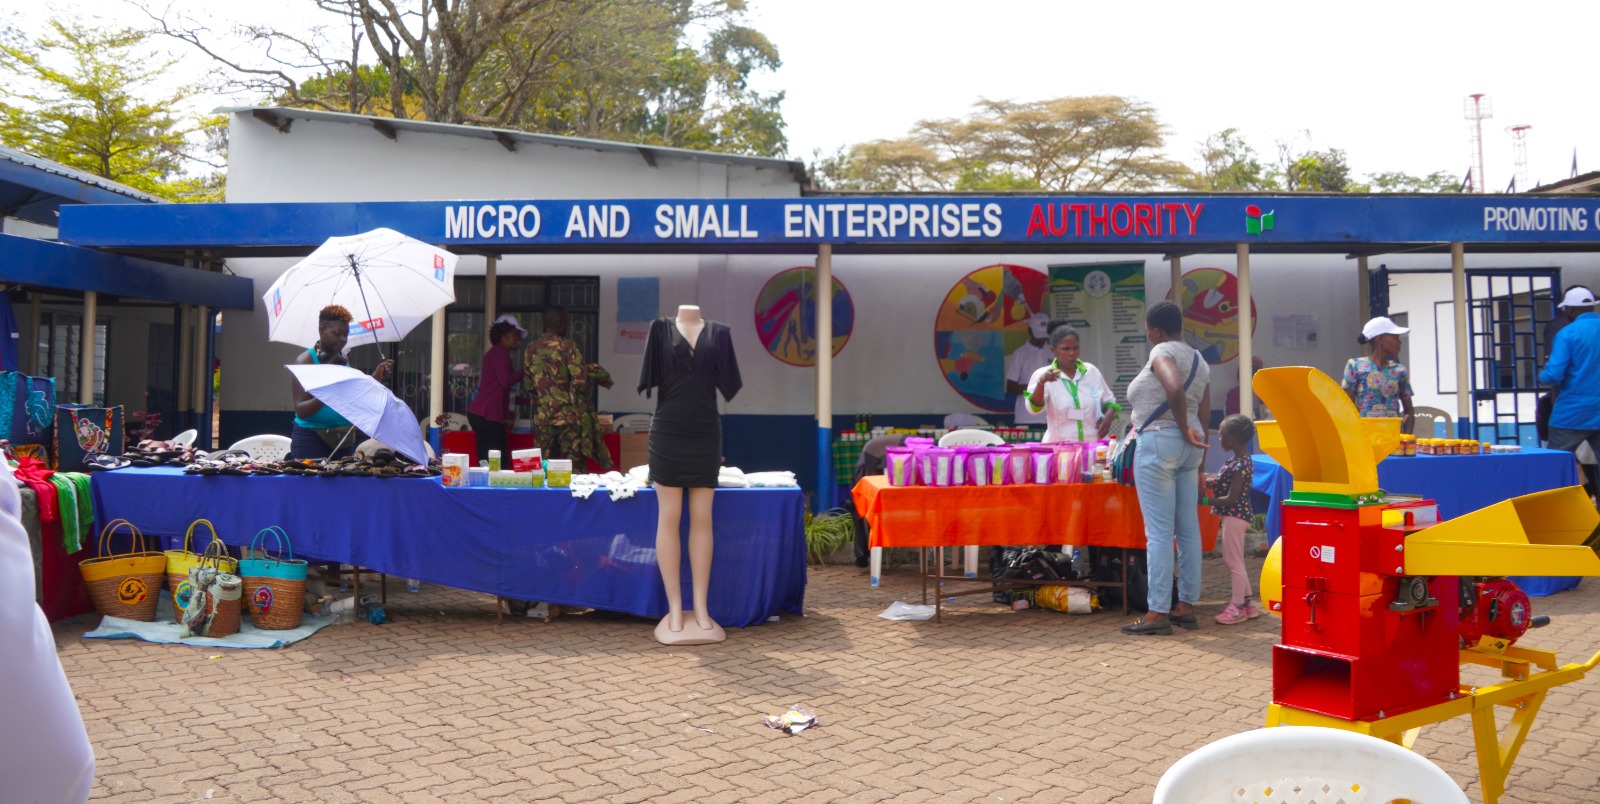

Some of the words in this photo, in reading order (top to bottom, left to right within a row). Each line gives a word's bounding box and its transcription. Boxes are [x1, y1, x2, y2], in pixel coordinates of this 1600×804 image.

[444, 205, 542, 239] MICRO
[564, 204, 631, 239] AND
[654, 204, 759, 239] SMALL
[784, 203, 1003, 238] ENTERPRISES
[1026, 203, 1204, 237] AUTHORITY
[1483, 206, 1588, 231] PROMOTING
